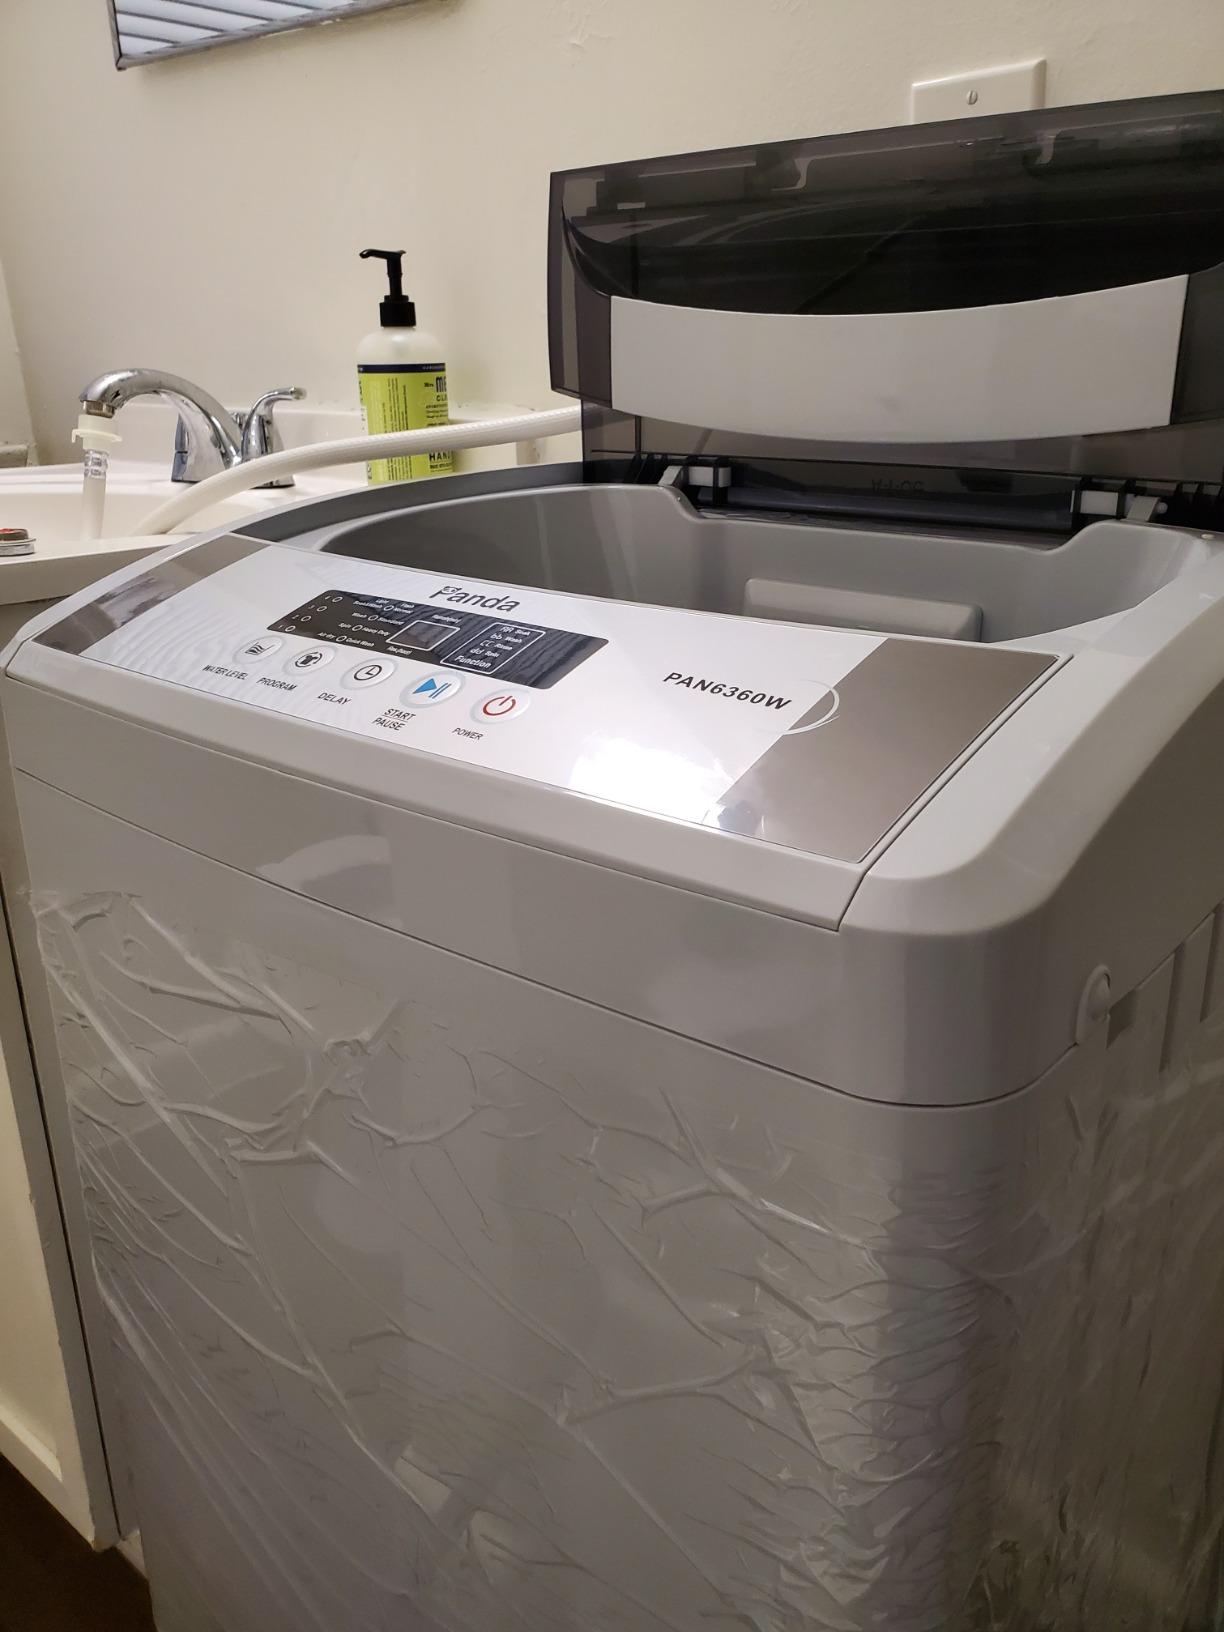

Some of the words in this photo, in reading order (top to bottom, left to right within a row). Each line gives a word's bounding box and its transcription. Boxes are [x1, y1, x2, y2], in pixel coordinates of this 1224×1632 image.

[429, 585, 521, 612] Panda
[454, 655, 492, 668] Function
[202, 664, 227, 677] WATER
[227, 669, 249, 681] LEVEL
[256, 677, 297, 691] PROGRAM
[662, 672, 792, 710] PAN6360W
[317, 692, 351, 705] DELAY
[384, 708, 416, 721] START
[372, 717, 405, 731] PAUSE
[452, 727, 484, 740] POWER
